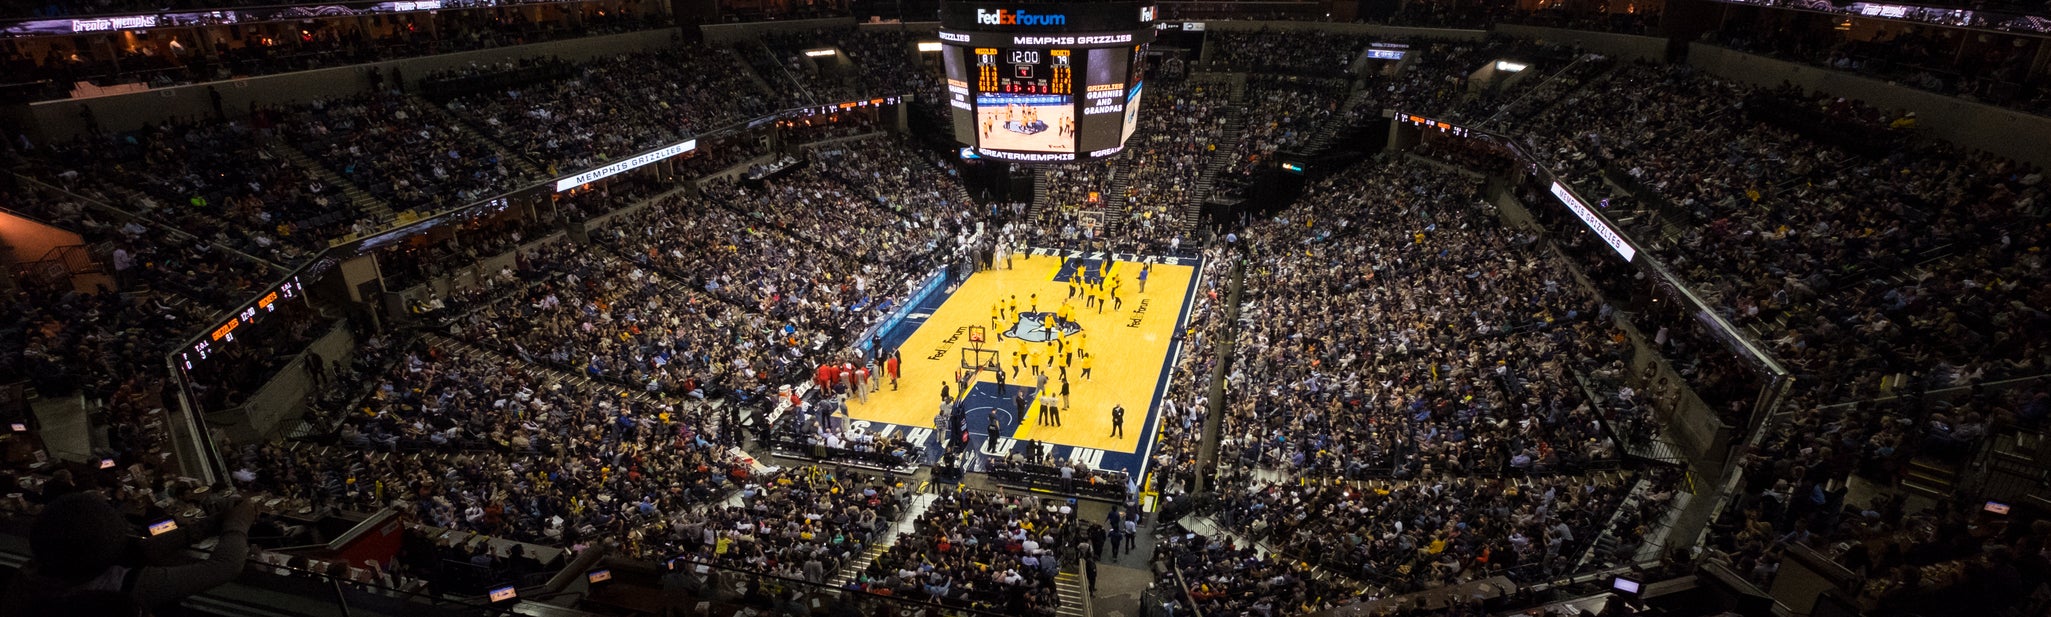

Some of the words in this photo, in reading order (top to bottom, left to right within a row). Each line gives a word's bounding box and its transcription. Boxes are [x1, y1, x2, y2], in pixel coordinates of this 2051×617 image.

[977, 8, 1066, 25] FedExForum
[73, 19, 111, 33] Greater
[1014, 36, 1075, 45] MEMPHIS
[1077, 34, 1132, 44] GRIZZLIES
[982, 54, 993, 63] 81
[1012, 51, 1038, 63] 12:00
[1057, 55, 1068, 64] 79
[1087, 83, 1124, 91] GRIZZLIES
[1087, 90, 1123, 99] GRANNIES
[1096, 98, 1112, 106] AND
[1084, 105, 1123, 115] GRANDPAS
[576, 163, 628, 184] MEMPHIS
[631, 145, 681, 166] GRIZZLIES
[1559, 189, 1585, 217] MEMPHIS
[1585, 213, 1621, 249] GRIZZLIES
[240, 307, 256, 322] 12:00
[225, 332, 234, 342] 81
